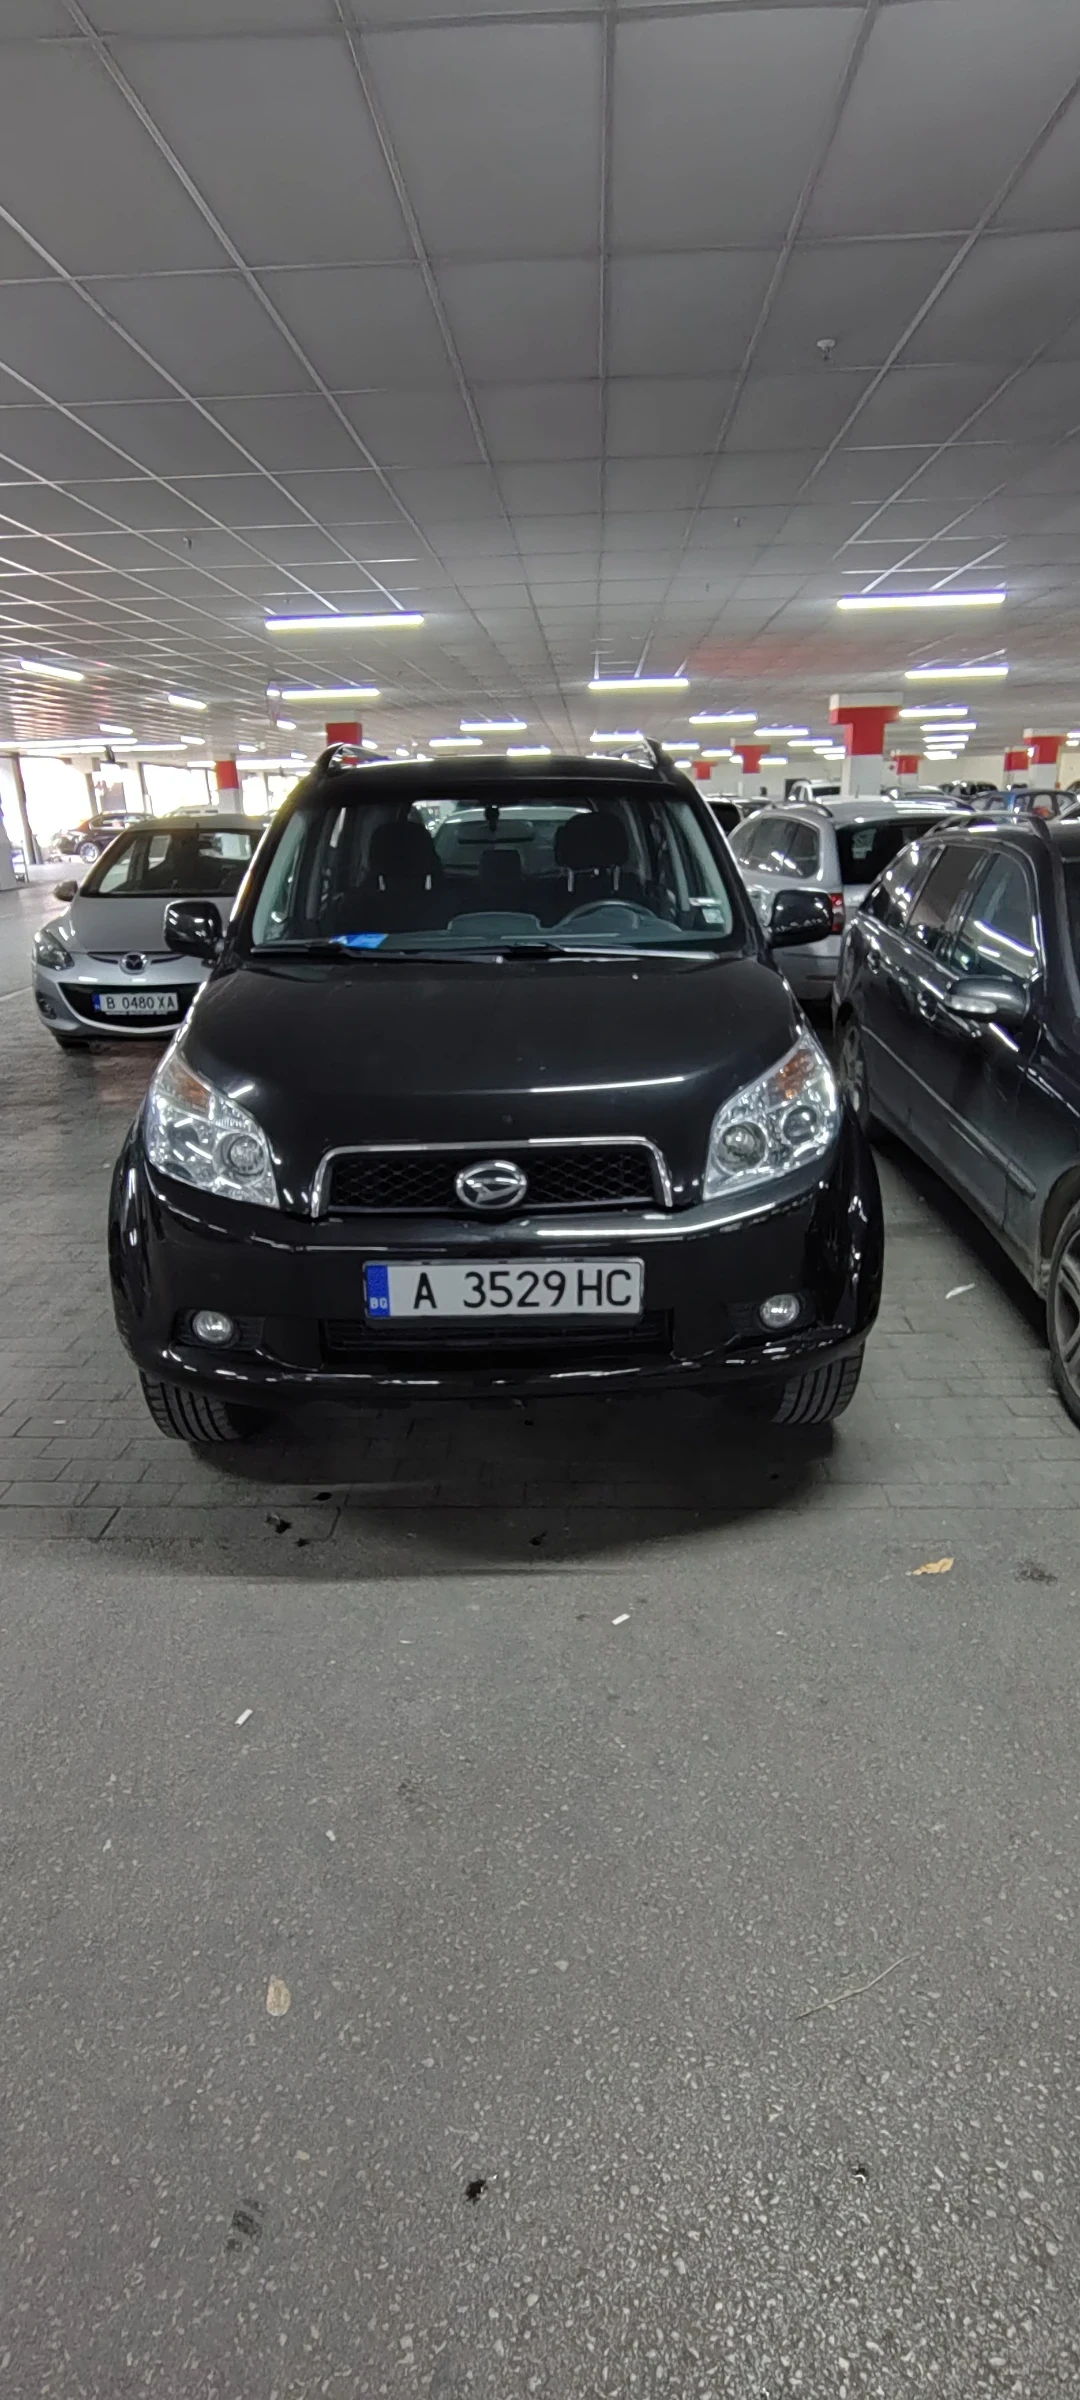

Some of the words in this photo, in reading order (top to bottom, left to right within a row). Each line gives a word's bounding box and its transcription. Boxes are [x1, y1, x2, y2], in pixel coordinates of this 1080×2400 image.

[106, 997, 115, 1010] B
[122, 997, 154, 1009] 0480
[157, 996, 175, 1009] XA
[413, 1272, 437, 1309] A
[463, 1271, 566, 1308] 3529
[577, 1269, 632, 1306] HC
[369, 1297, 388, 1309] BG
